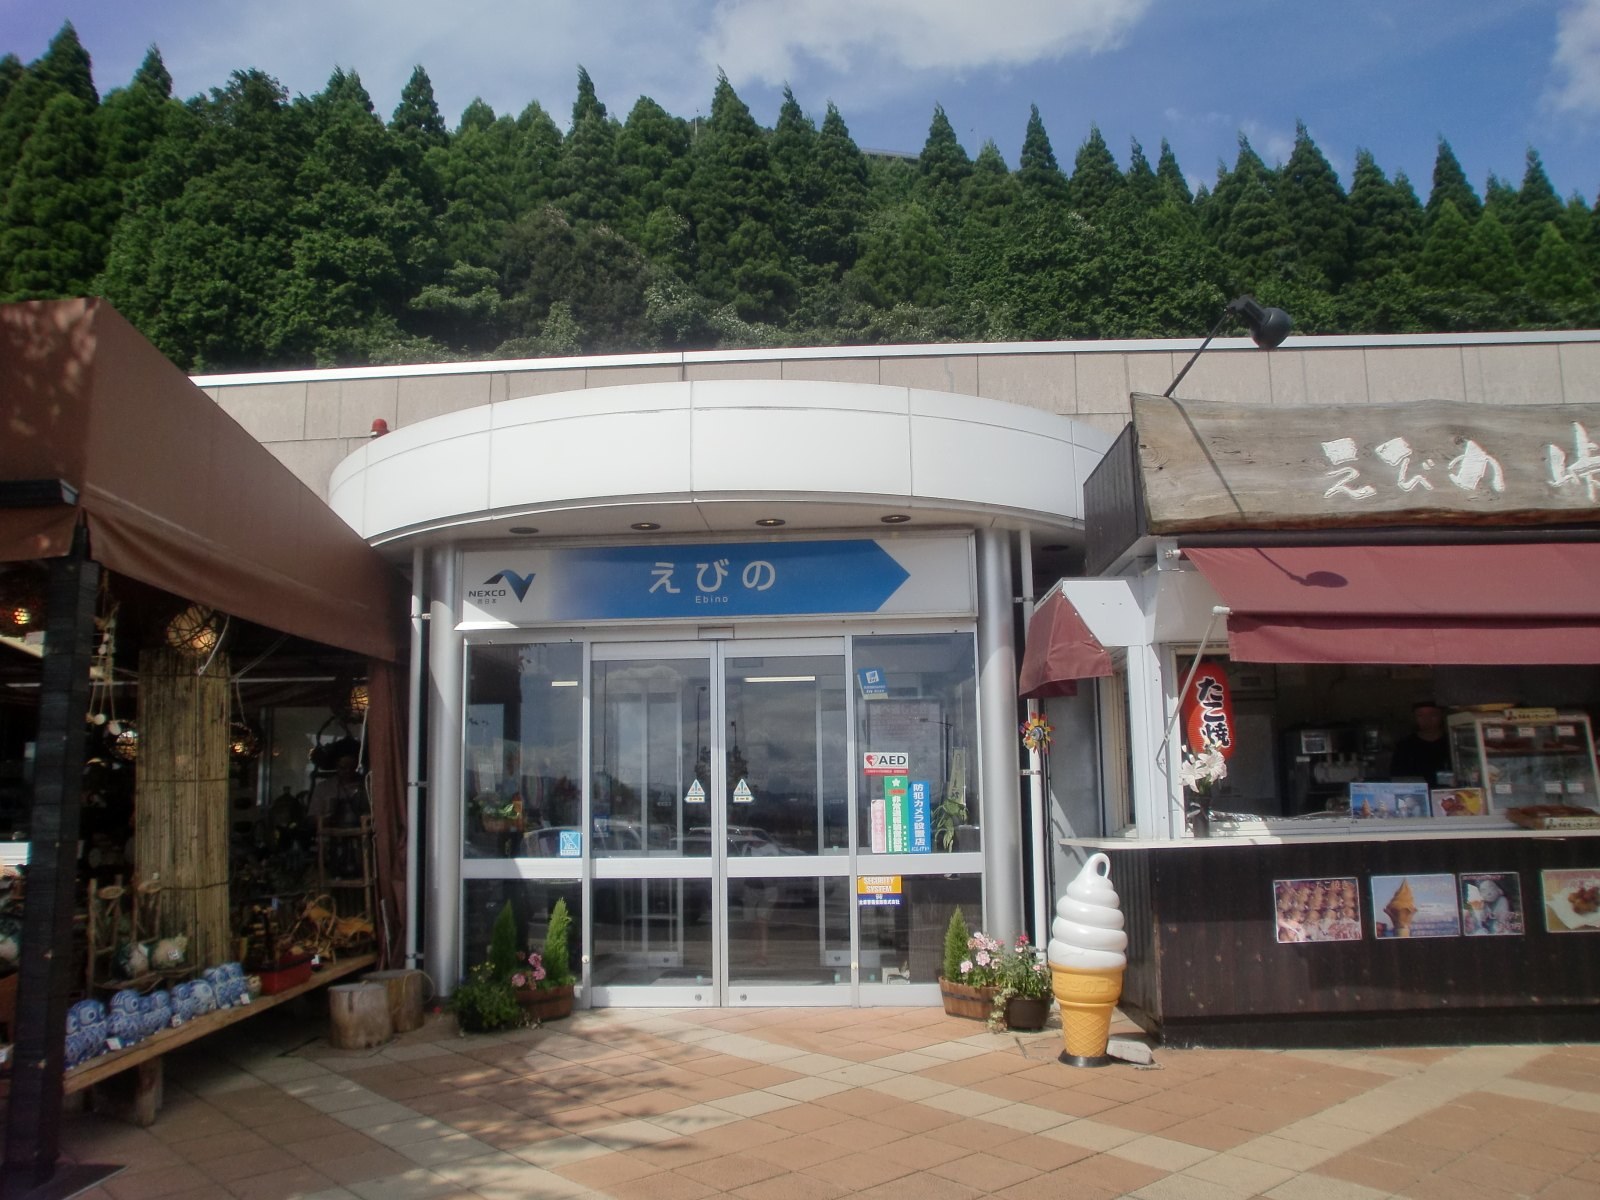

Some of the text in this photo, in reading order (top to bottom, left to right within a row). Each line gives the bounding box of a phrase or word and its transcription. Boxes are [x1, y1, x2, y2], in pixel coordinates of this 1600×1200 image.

[648, 558, 776, 593] えびの
[468, 589, 506, 597] NEXCO
[695, 595, 729, 604] Ebino
[878, 755, 906, 765] AED
[913, 783, 926, 846] 防犯カメラ設置店
[863, 875, 893, 884] SECURITY
[866, 885, 892, 893] SYSTEM
